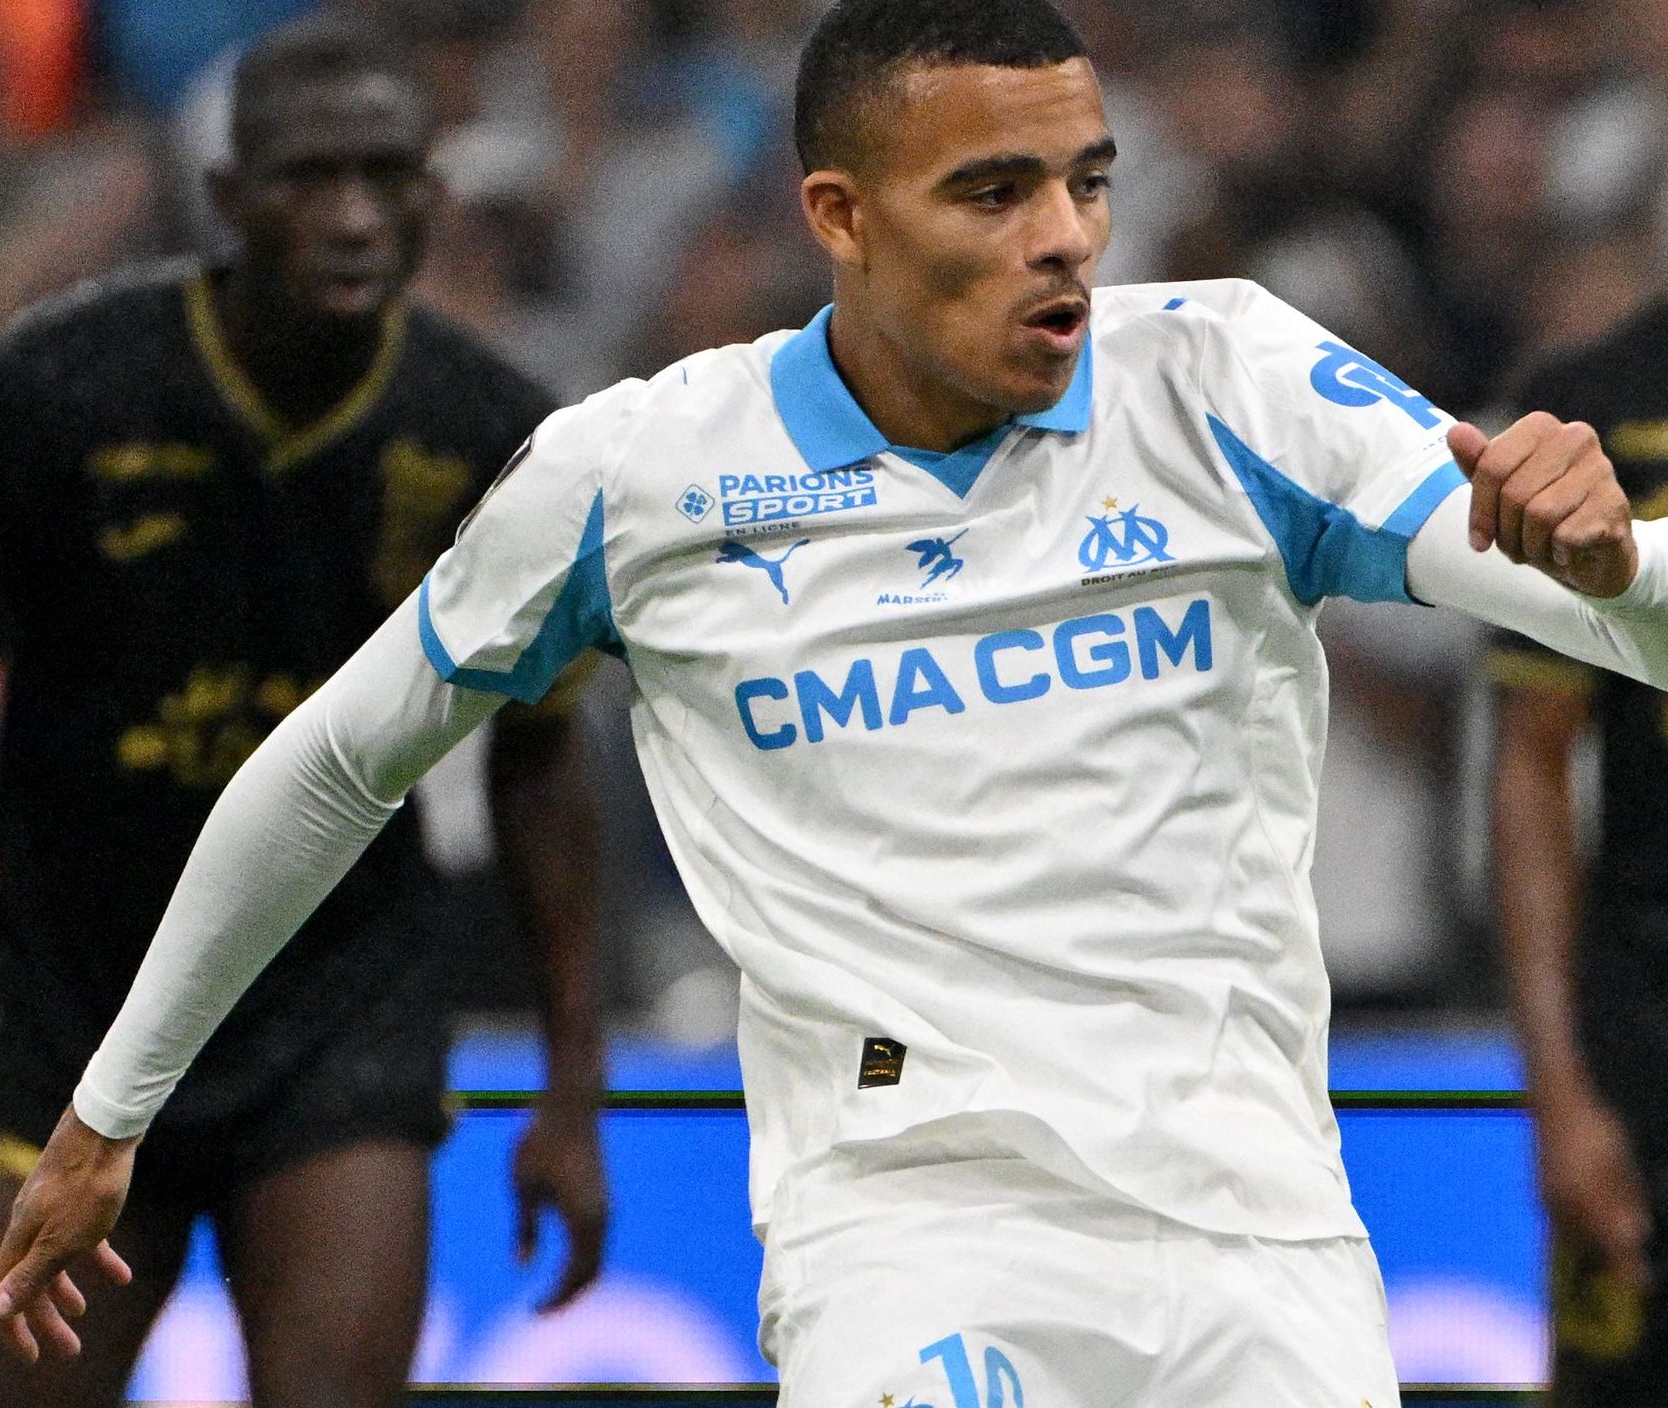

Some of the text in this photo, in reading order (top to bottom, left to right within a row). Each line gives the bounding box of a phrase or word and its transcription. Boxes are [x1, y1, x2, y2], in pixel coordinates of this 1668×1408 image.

[718, 469, 875, 498] PARIONS
[727, 488, 873, 524] SPORT
[1081, 573, 1125, 587] DROIT
[734, 599, 1215, 751] CMA CGM
